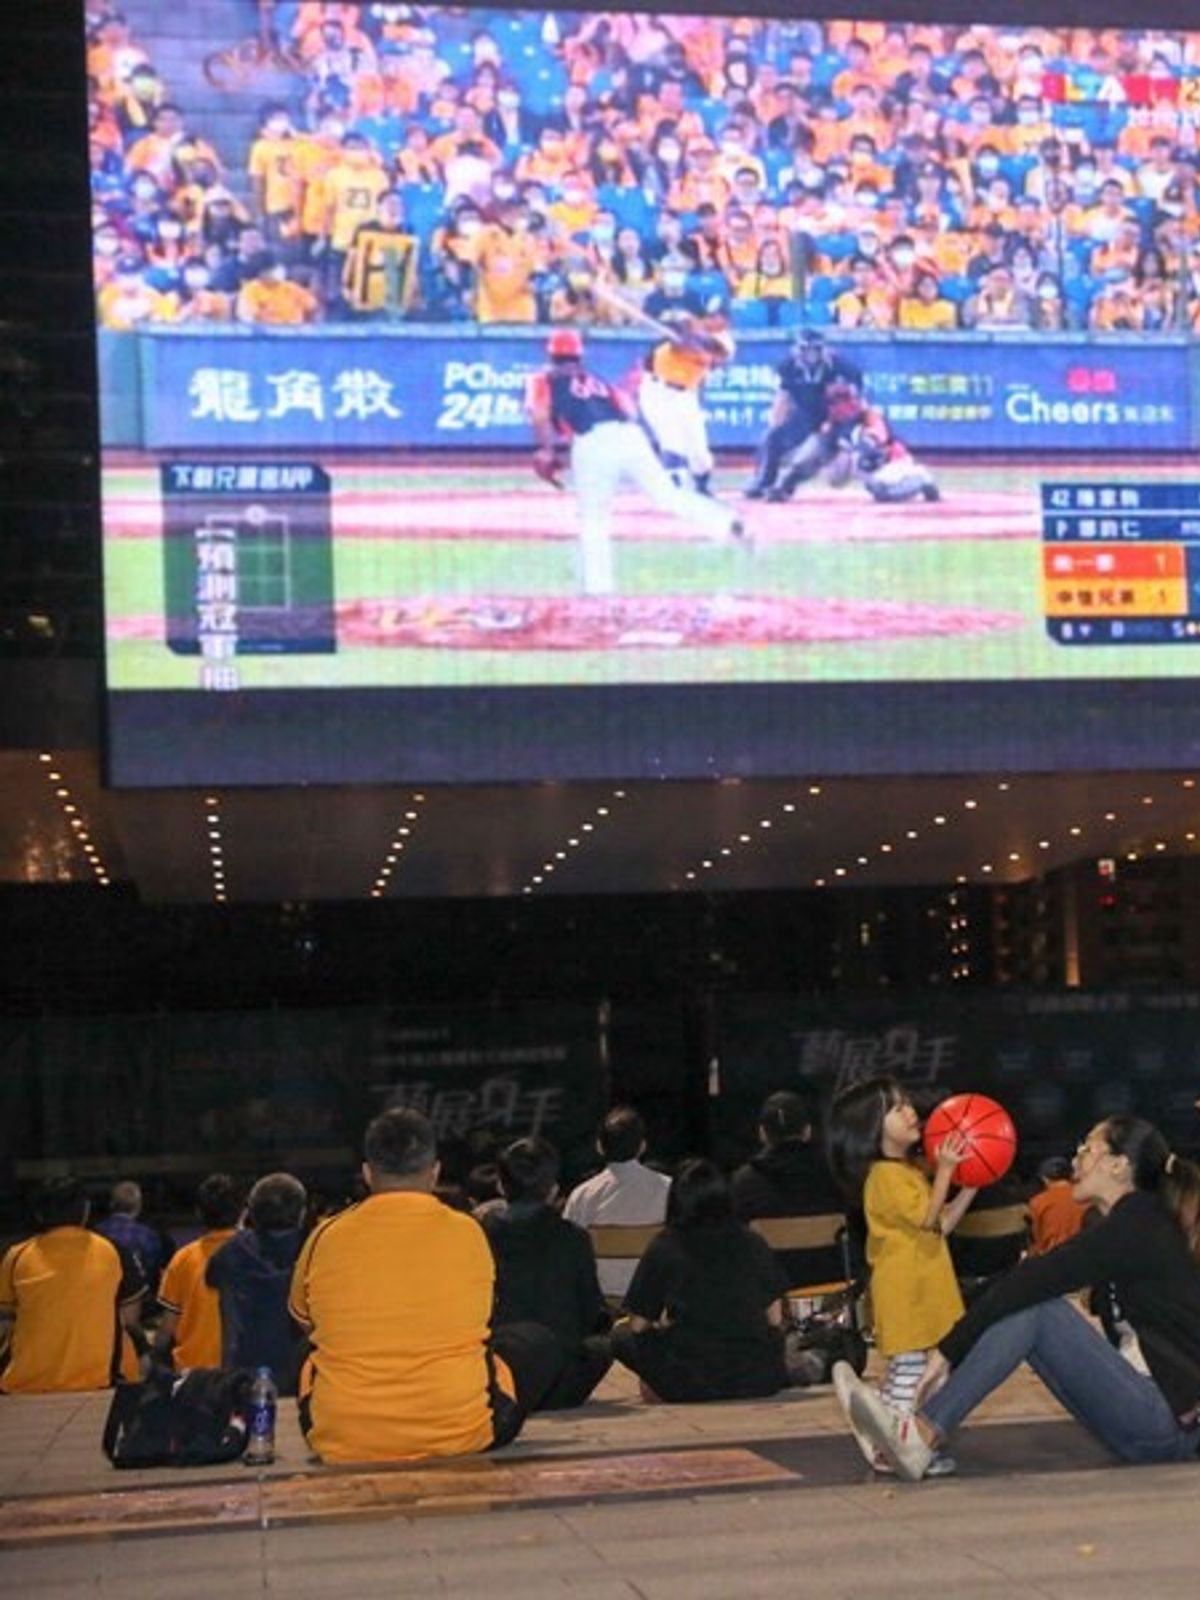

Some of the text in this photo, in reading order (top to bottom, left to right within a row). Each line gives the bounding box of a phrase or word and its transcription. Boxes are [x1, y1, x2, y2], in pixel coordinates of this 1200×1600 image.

[188, 367, 402, 422] 龍角散
[1006, 391, 1119, 424] Cheers
